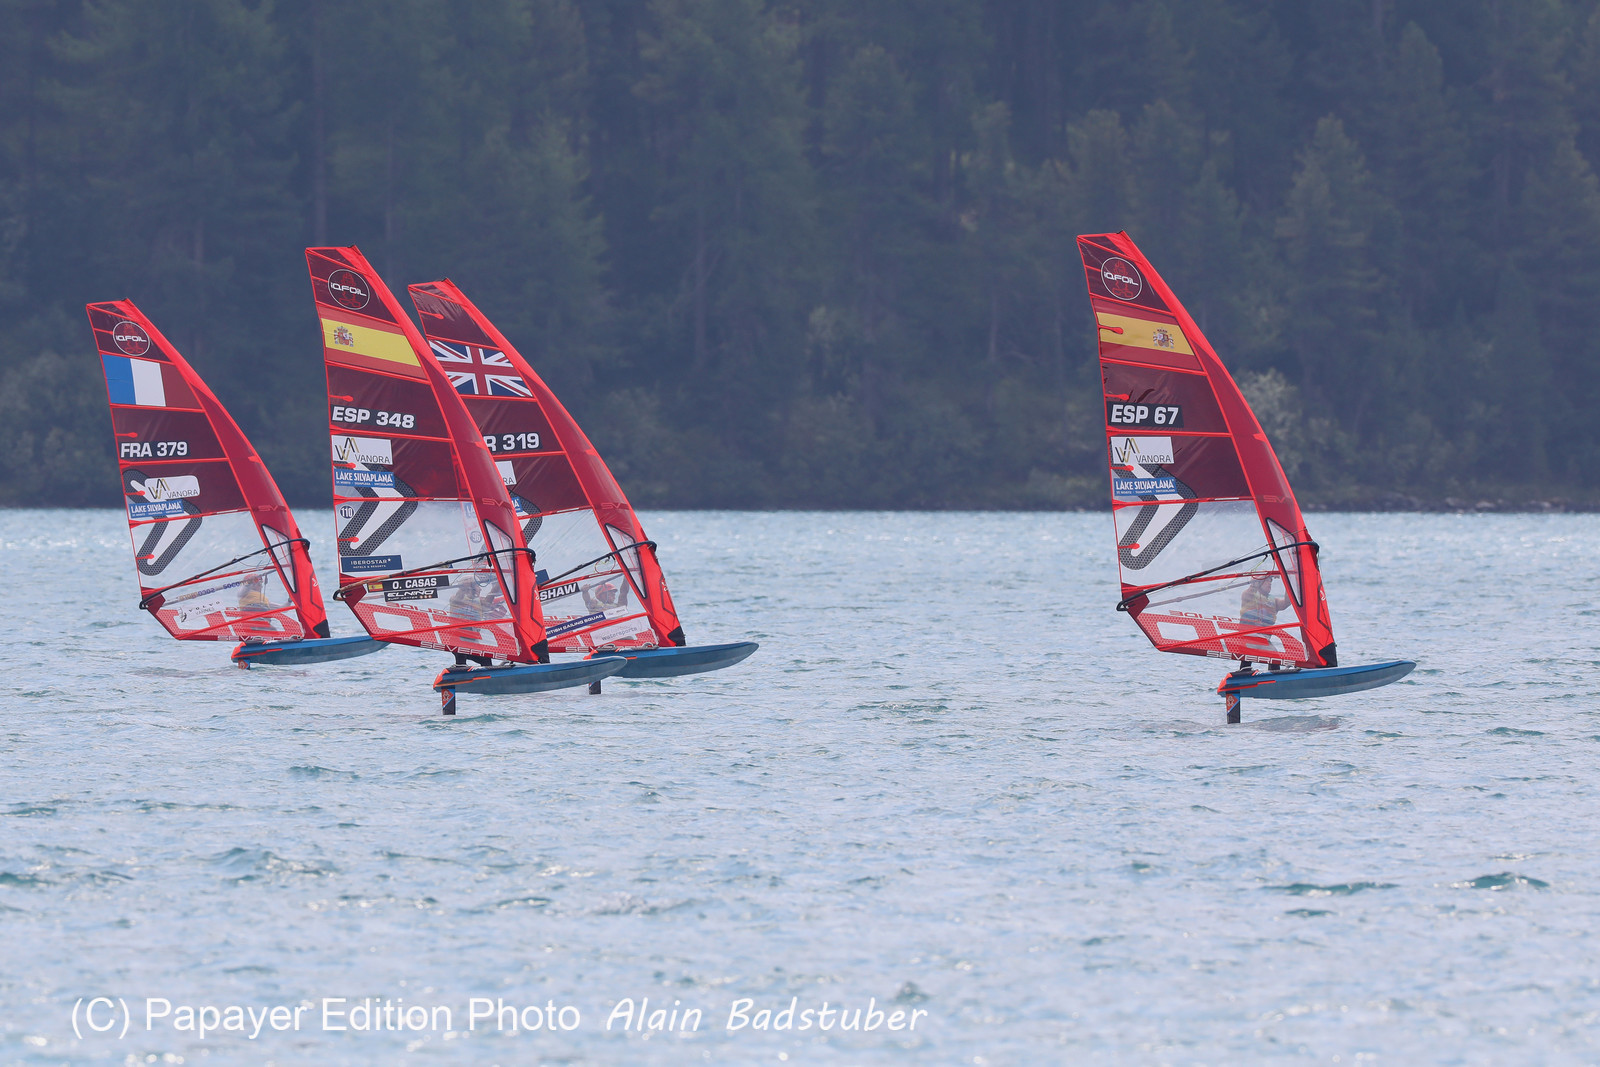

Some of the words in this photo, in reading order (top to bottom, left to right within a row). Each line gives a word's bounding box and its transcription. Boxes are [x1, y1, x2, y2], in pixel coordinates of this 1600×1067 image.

[331, 406, 371, 423] ESP
[376, 411, 415, 428] 348
[1110, 404, 1149, 424] ESP
[1154, 406, 1179, 425] 67
[502, 432, 540, 451] 319
[120, 442, 152, 458] FRA
[157, 441, 188, 456] 379
[355, 454, 390, 464] VANORA
[1135, 454, 1172, 463] VANORA
[335, 471, 353, 481] LAKE
[353, 472, 393, 483] SILVAPLANA
[1115, 480, 1134, 490] LAKE
[1134, 479, 1175, 490] SILVAPLANA
[166, 489, 199, 499] VANORA
[130, 504, 147, 514] LAKE
[147, 501, 182, 512] SILVAPLANA
[340, 507, 354, 518] 110
[392, 581, 402, 590] O.
[405, 577, 437, 588] CASAS
[420, 640, 508, 660] SEVERNE
[1206, 650, 1296, 667] SEVERNE
